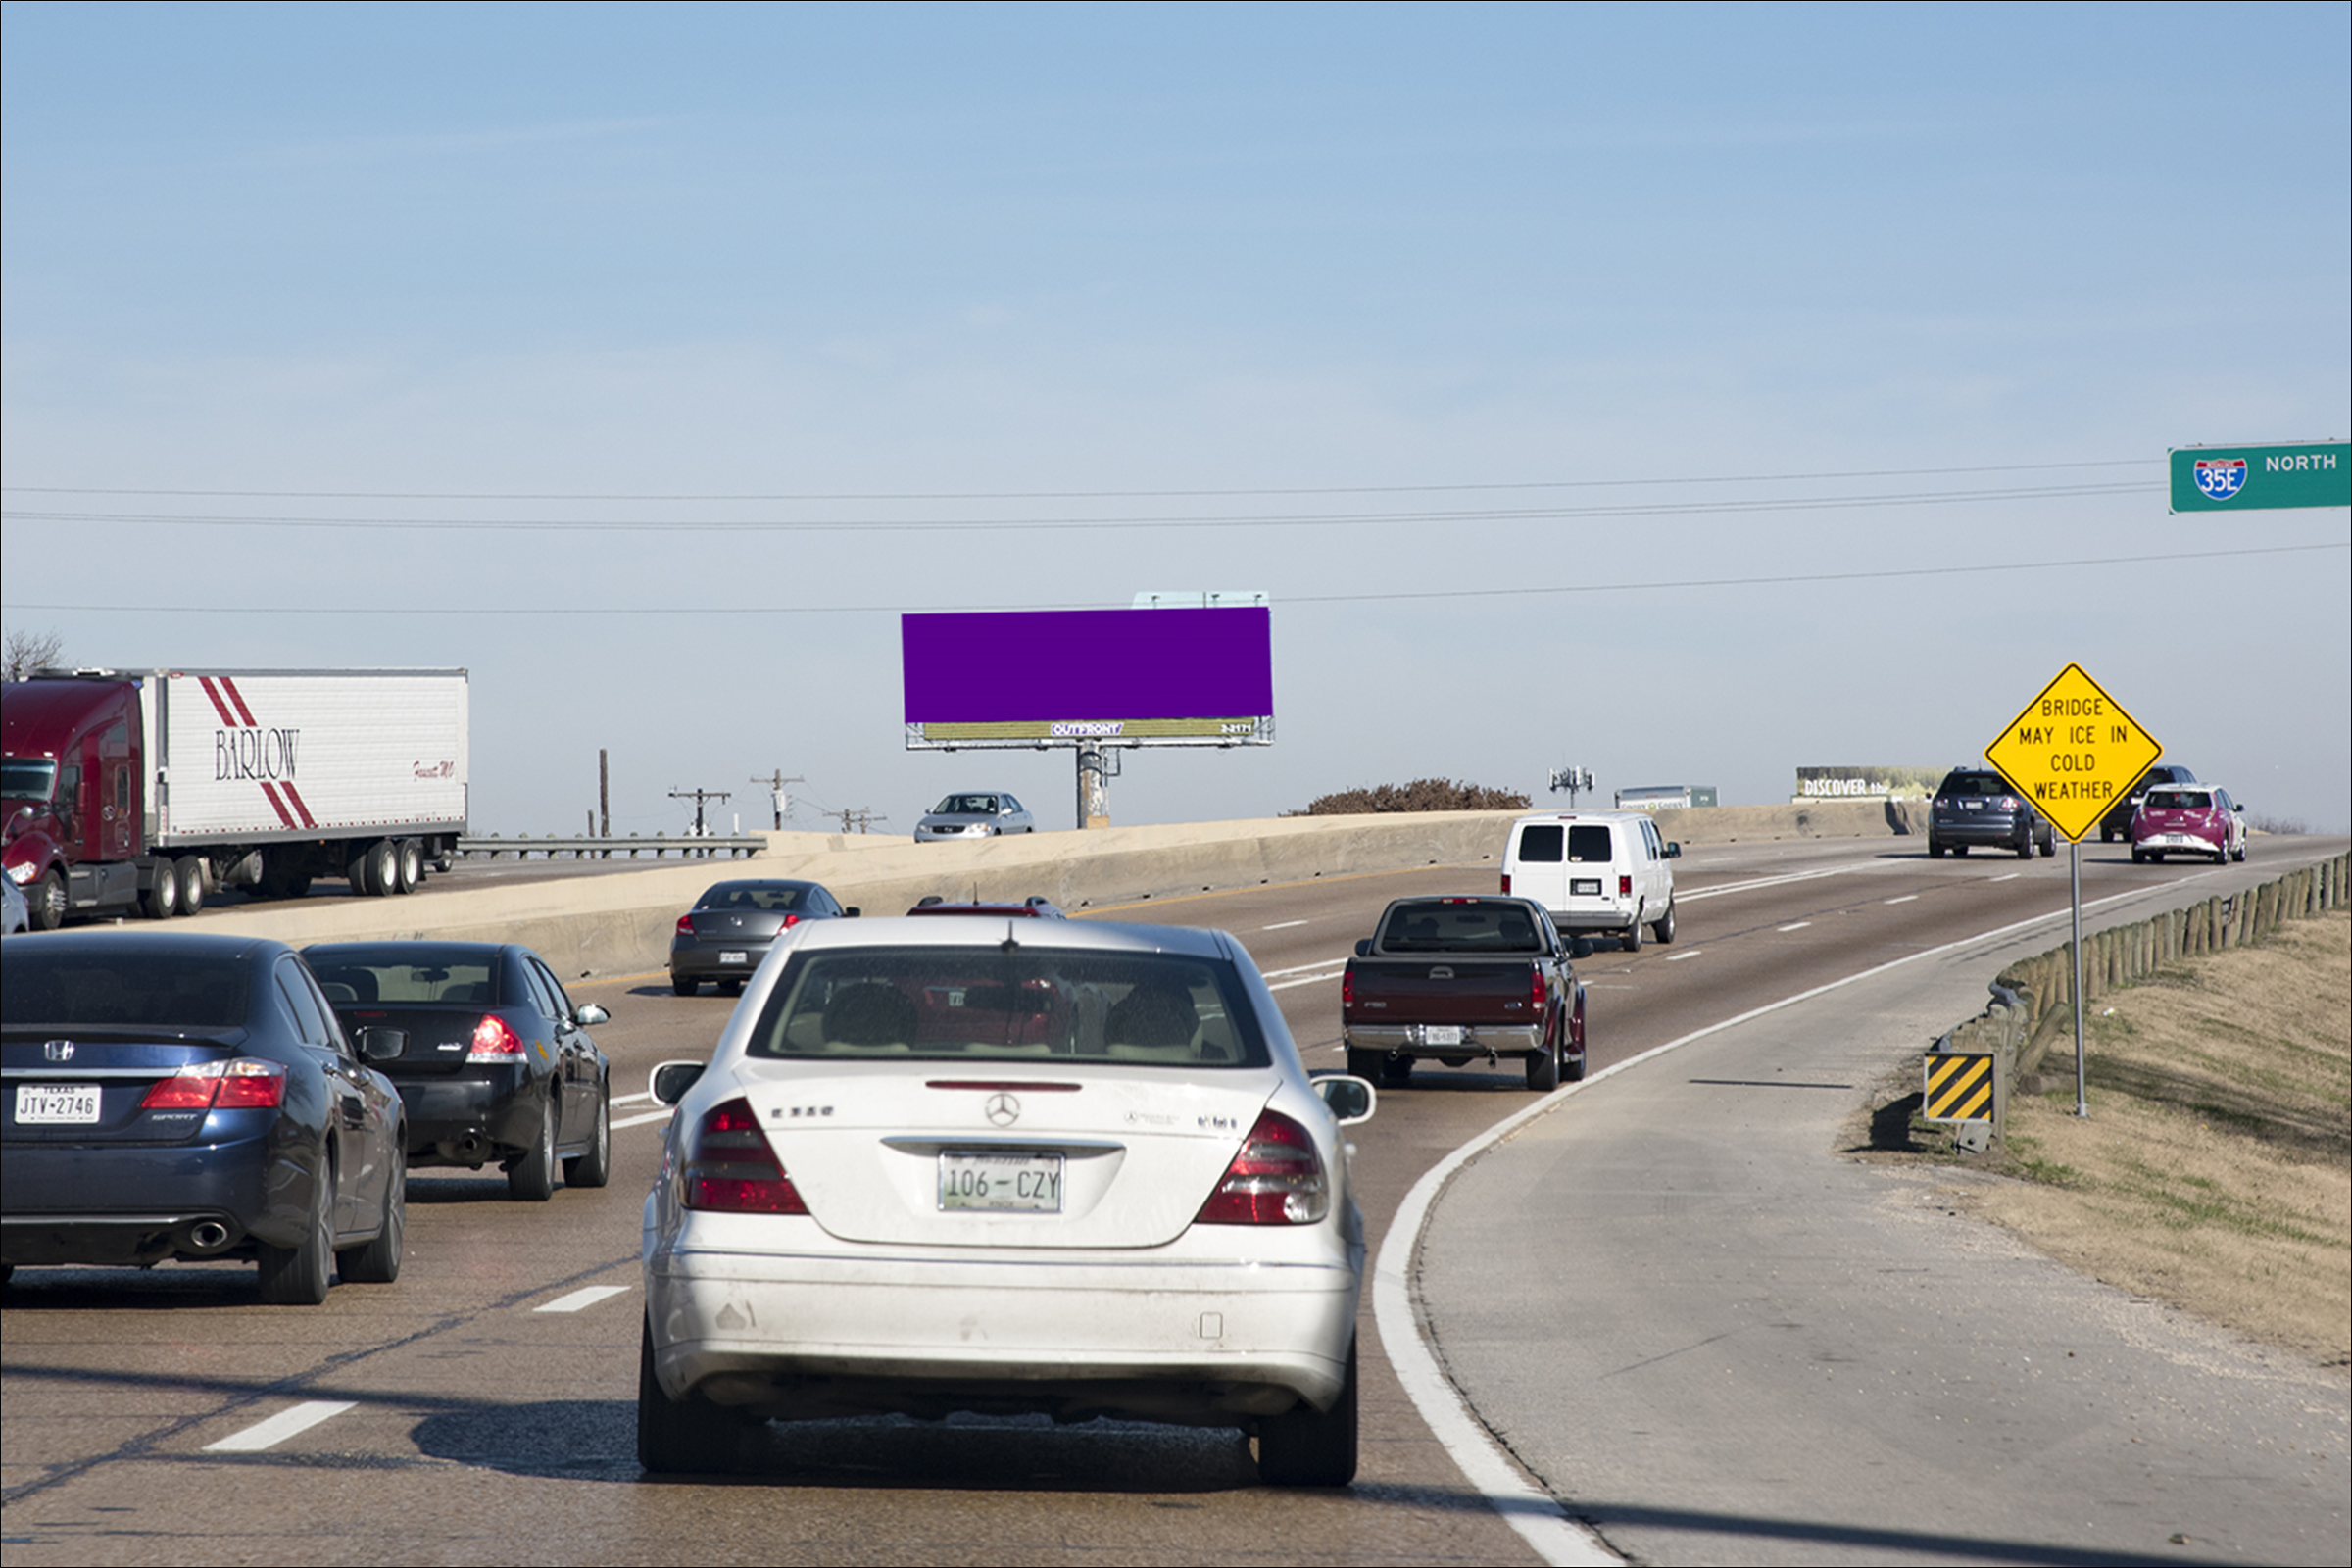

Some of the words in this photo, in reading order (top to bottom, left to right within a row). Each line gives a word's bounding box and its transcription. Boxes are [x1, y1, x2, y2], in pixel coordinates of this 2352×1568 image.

[2266, 454, 2336, 471] NORTH
[2201, 468, 2238, 491] 35E
[2042, 698, 2103, 716] BRIDGE
[1054, 724, 1119, 735] OUTFRONT
[2019, 726, 2054, 745] MAY
[2070, 725, 2095, 744] ICE
[2111, 725, 2127, 743] IN
[215, 727, 300, 781] BARLOW
[2050, 754, 2095, 772] COLD
[1804, 778, 1867, 796] DISCOVER
[2034, 781, 2113, 800] WEATHER
[20, 1097, 94, 1115] JTV-2746
